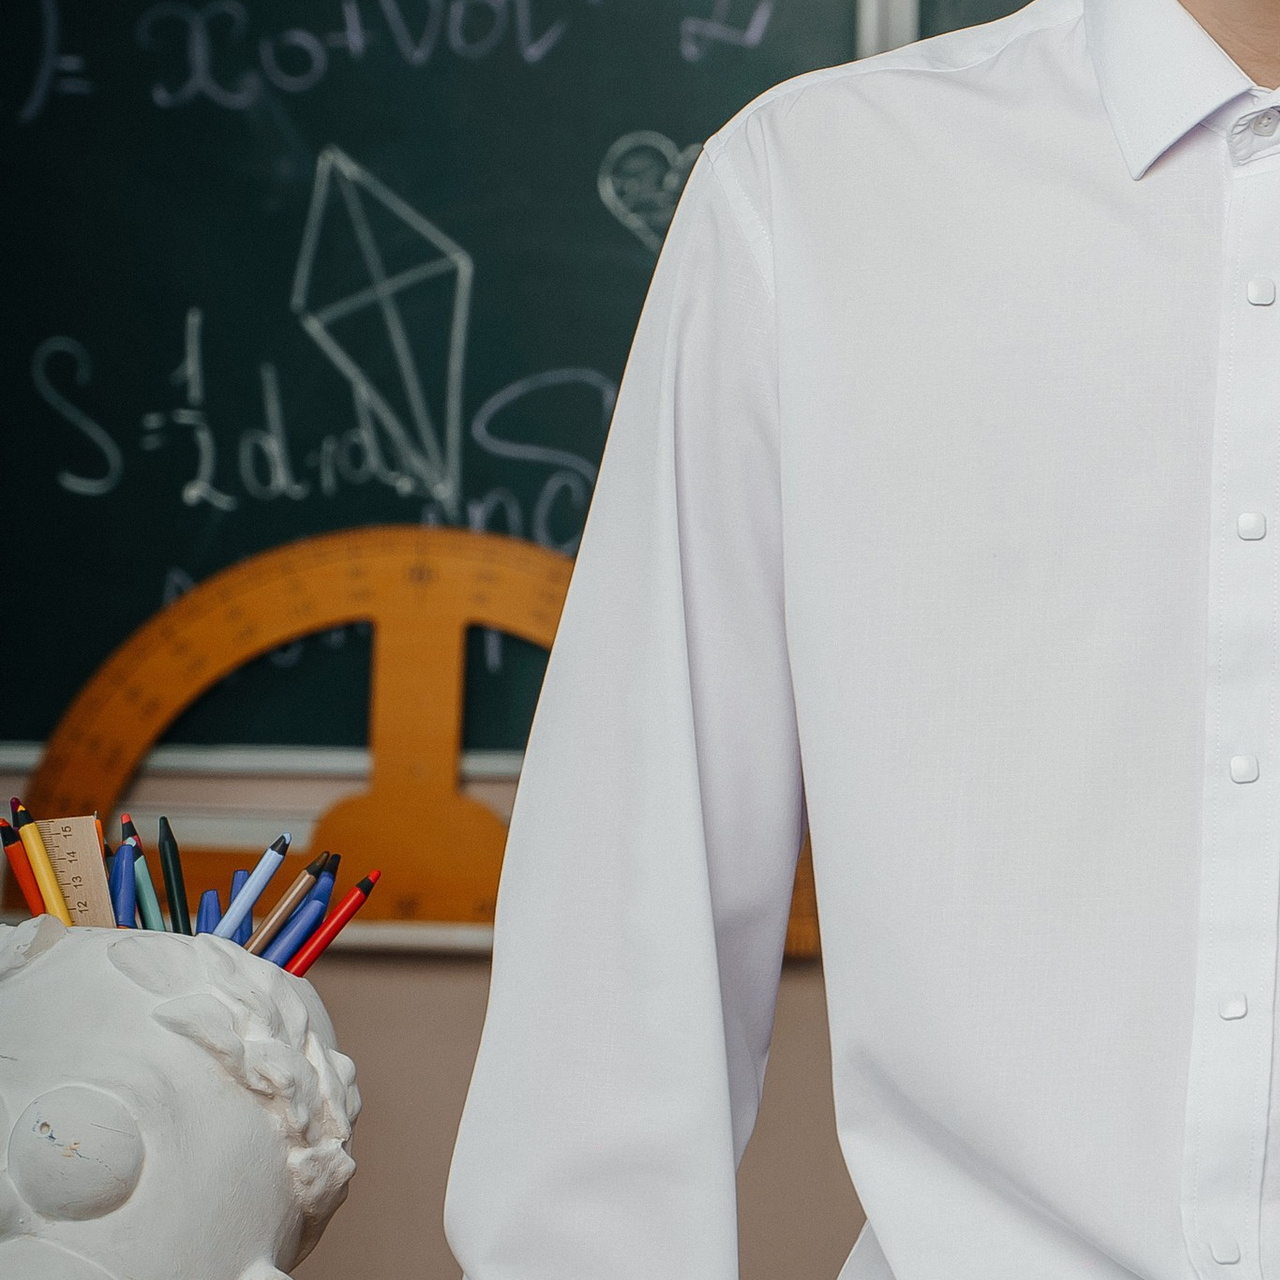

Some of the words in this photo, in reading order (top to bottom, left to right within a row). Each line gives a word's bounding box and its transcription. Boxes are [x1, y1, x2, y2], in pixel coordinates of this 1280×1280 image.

[61, 825, 73, 839] 15
[66, 851, 78, 864] 14
[71, 875, 83, 889] 13
[77, 900, 89, 914] 12
